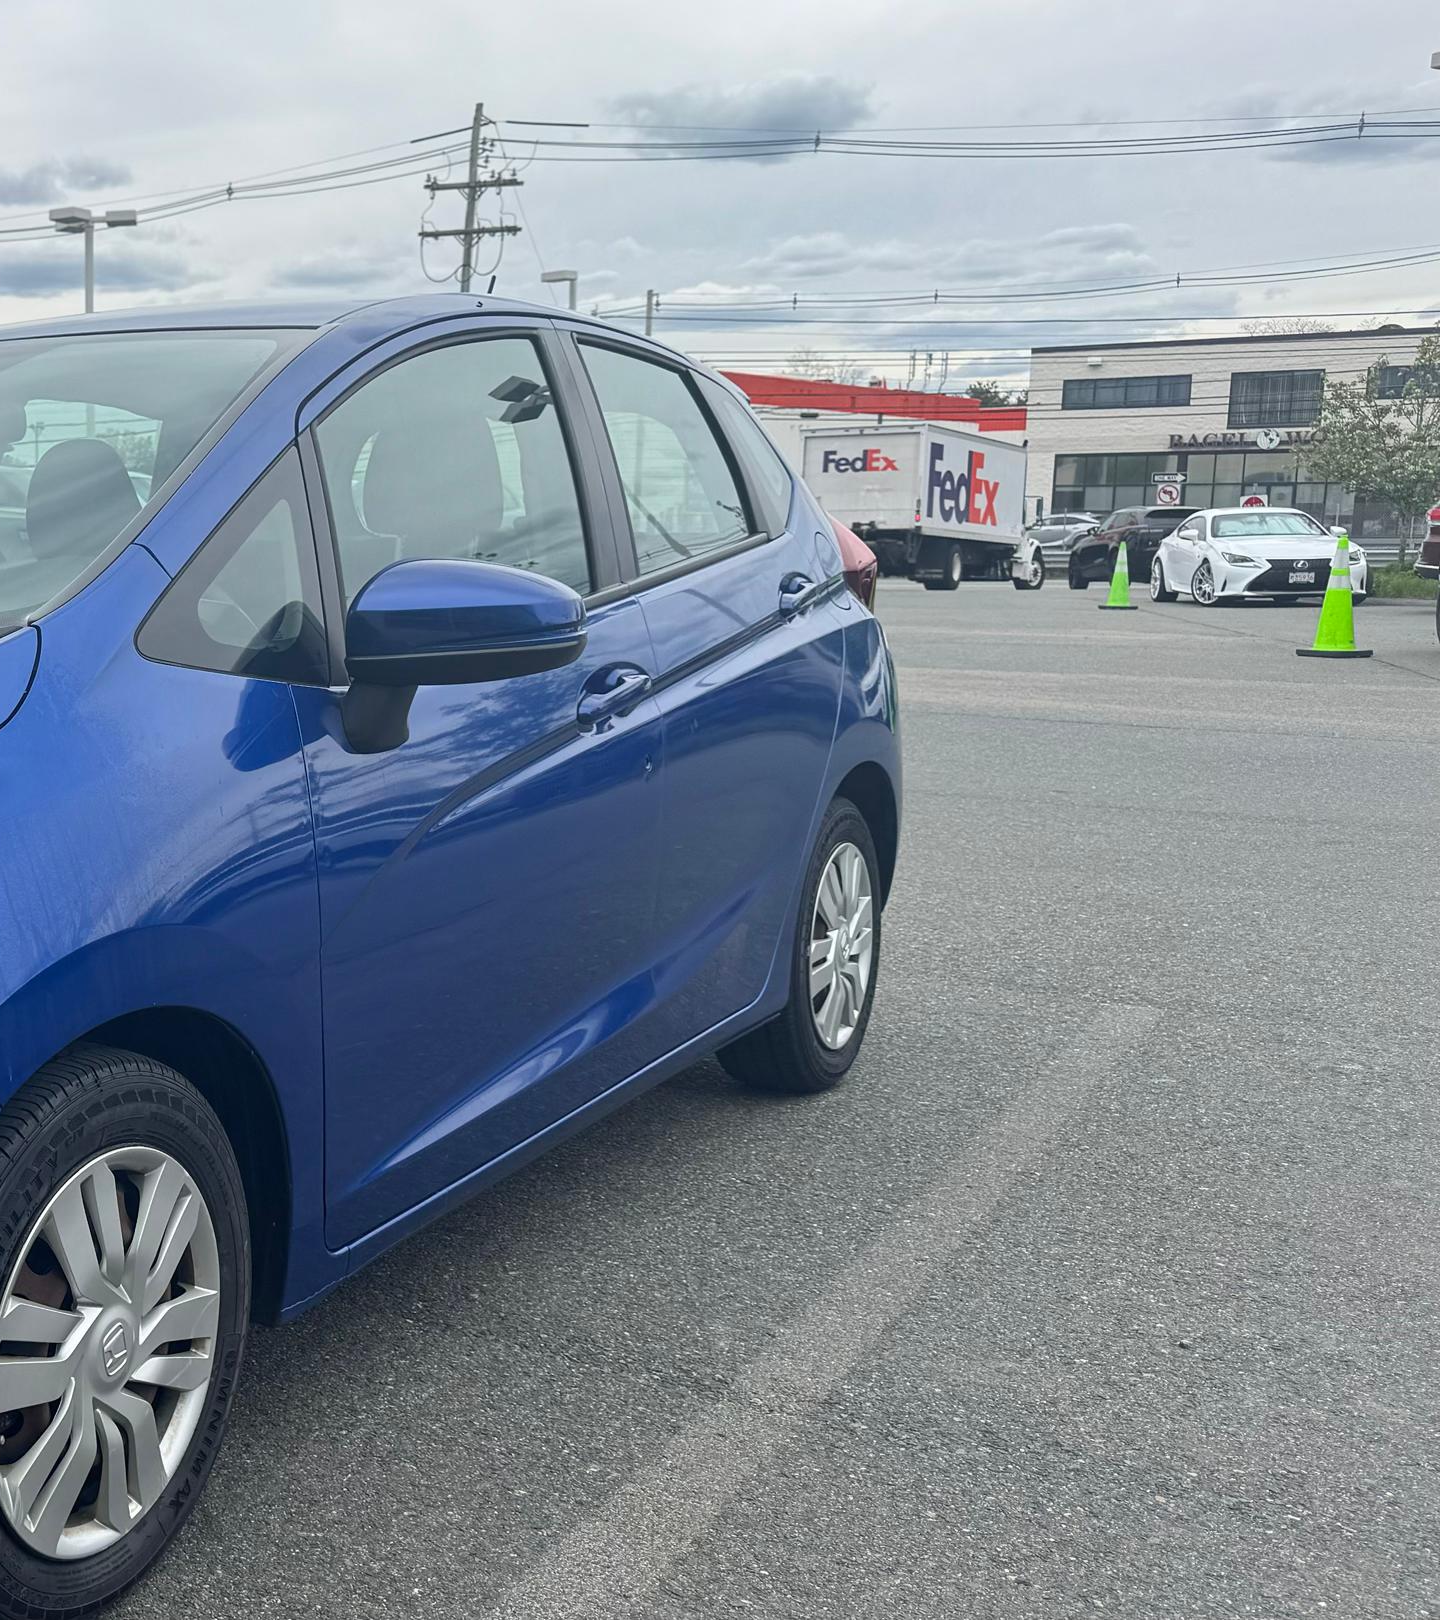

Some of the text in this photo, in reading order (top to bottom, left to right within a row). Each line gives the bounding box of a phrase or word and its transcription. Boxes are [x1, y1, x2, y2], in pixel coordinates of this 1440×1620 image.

[1168, 432, 1249, 449] BAGEL
[822, 448, 899, 474] FedEx
[926, 441, 1000, 527] FedEx
